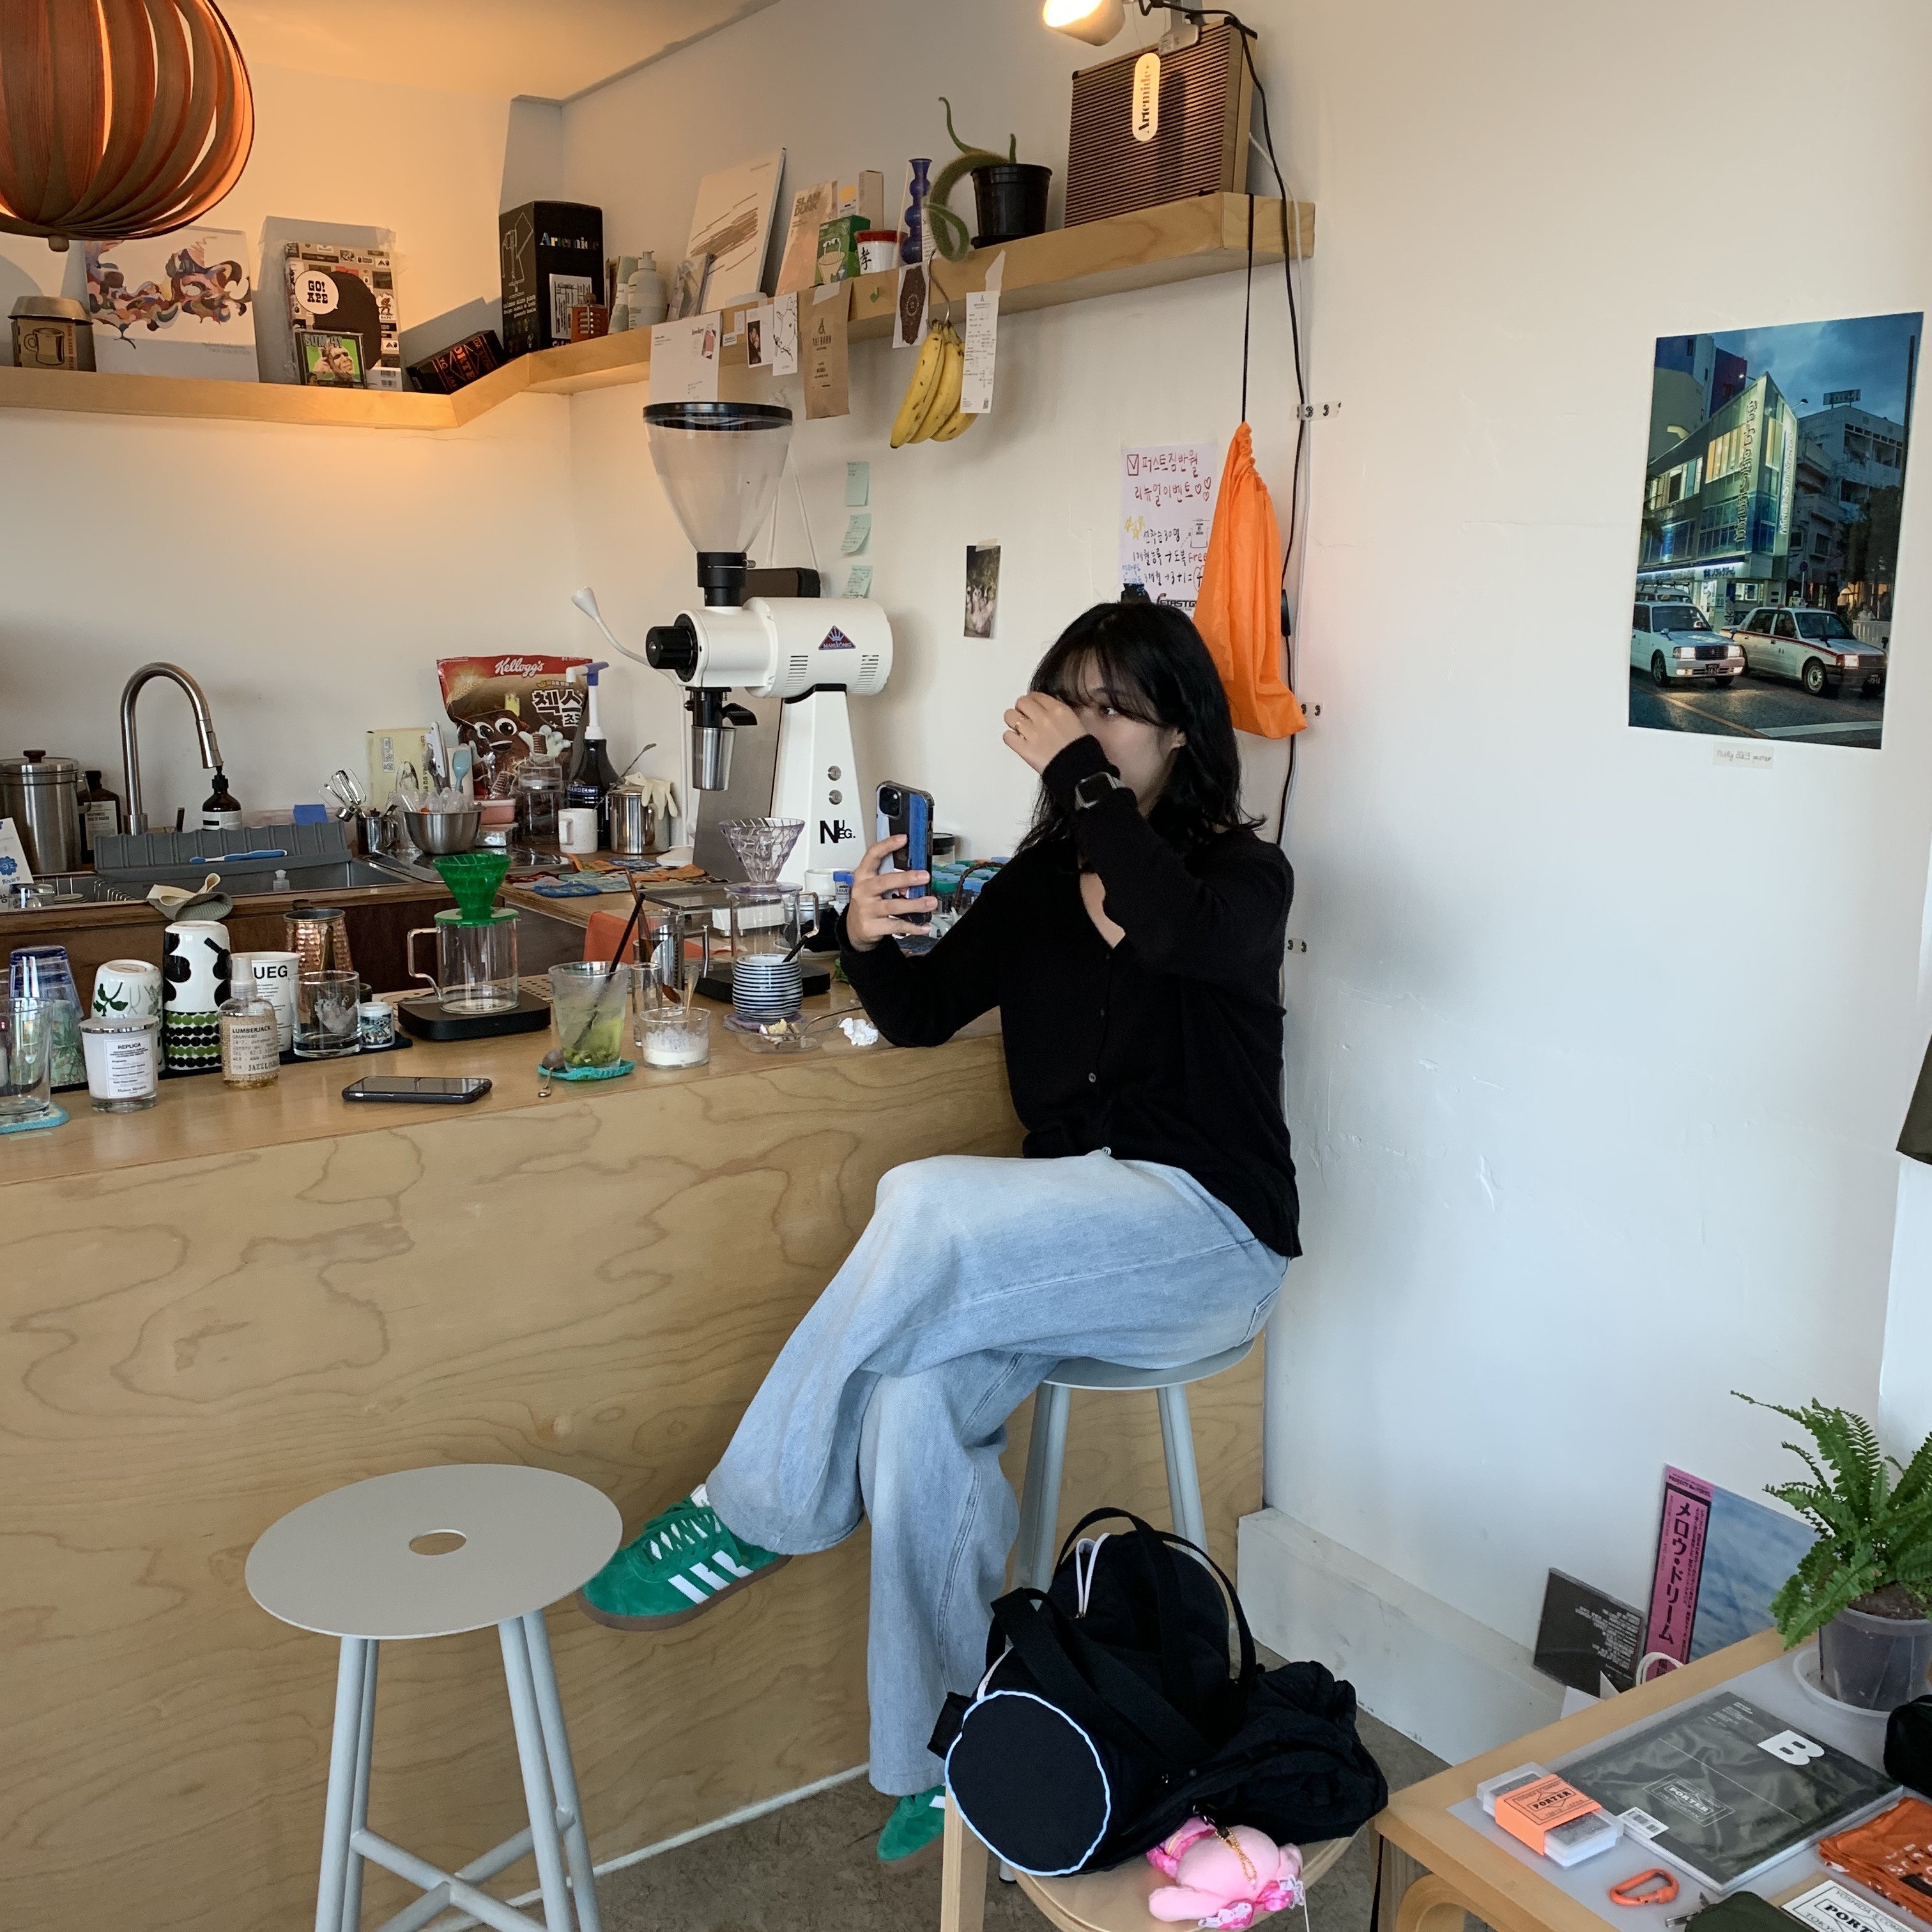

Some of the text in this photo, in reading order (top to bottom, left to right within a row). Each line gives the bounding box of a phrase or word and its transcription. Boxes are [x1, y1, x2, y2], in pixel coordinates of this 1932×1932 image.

[797, 191, 821, 205] SLAM
[794, 201, 818, 217] DUNK
[308, 280, 326, 293] GO!
[307, 293, 328, 303] APE
[303, 334, 342, 349] SUM 41
[495, 657, 545, 677] Kellogg's
[532, 689, 583, 715] 첵스
[254, 965, 288, 979] UEG
[233, 1025, 271, 1034] LUMBERJACK
[1659, 1502, 1691, 1645] メロウ・ドリーム
[1757, 1729, 1825, 1766] B
[1533, 1791, 1572, 1809] PORTER
[1669, 1786, 1708, 1813] PORTER
[1836, 1890, 1872, 1915] YOSHIDA
